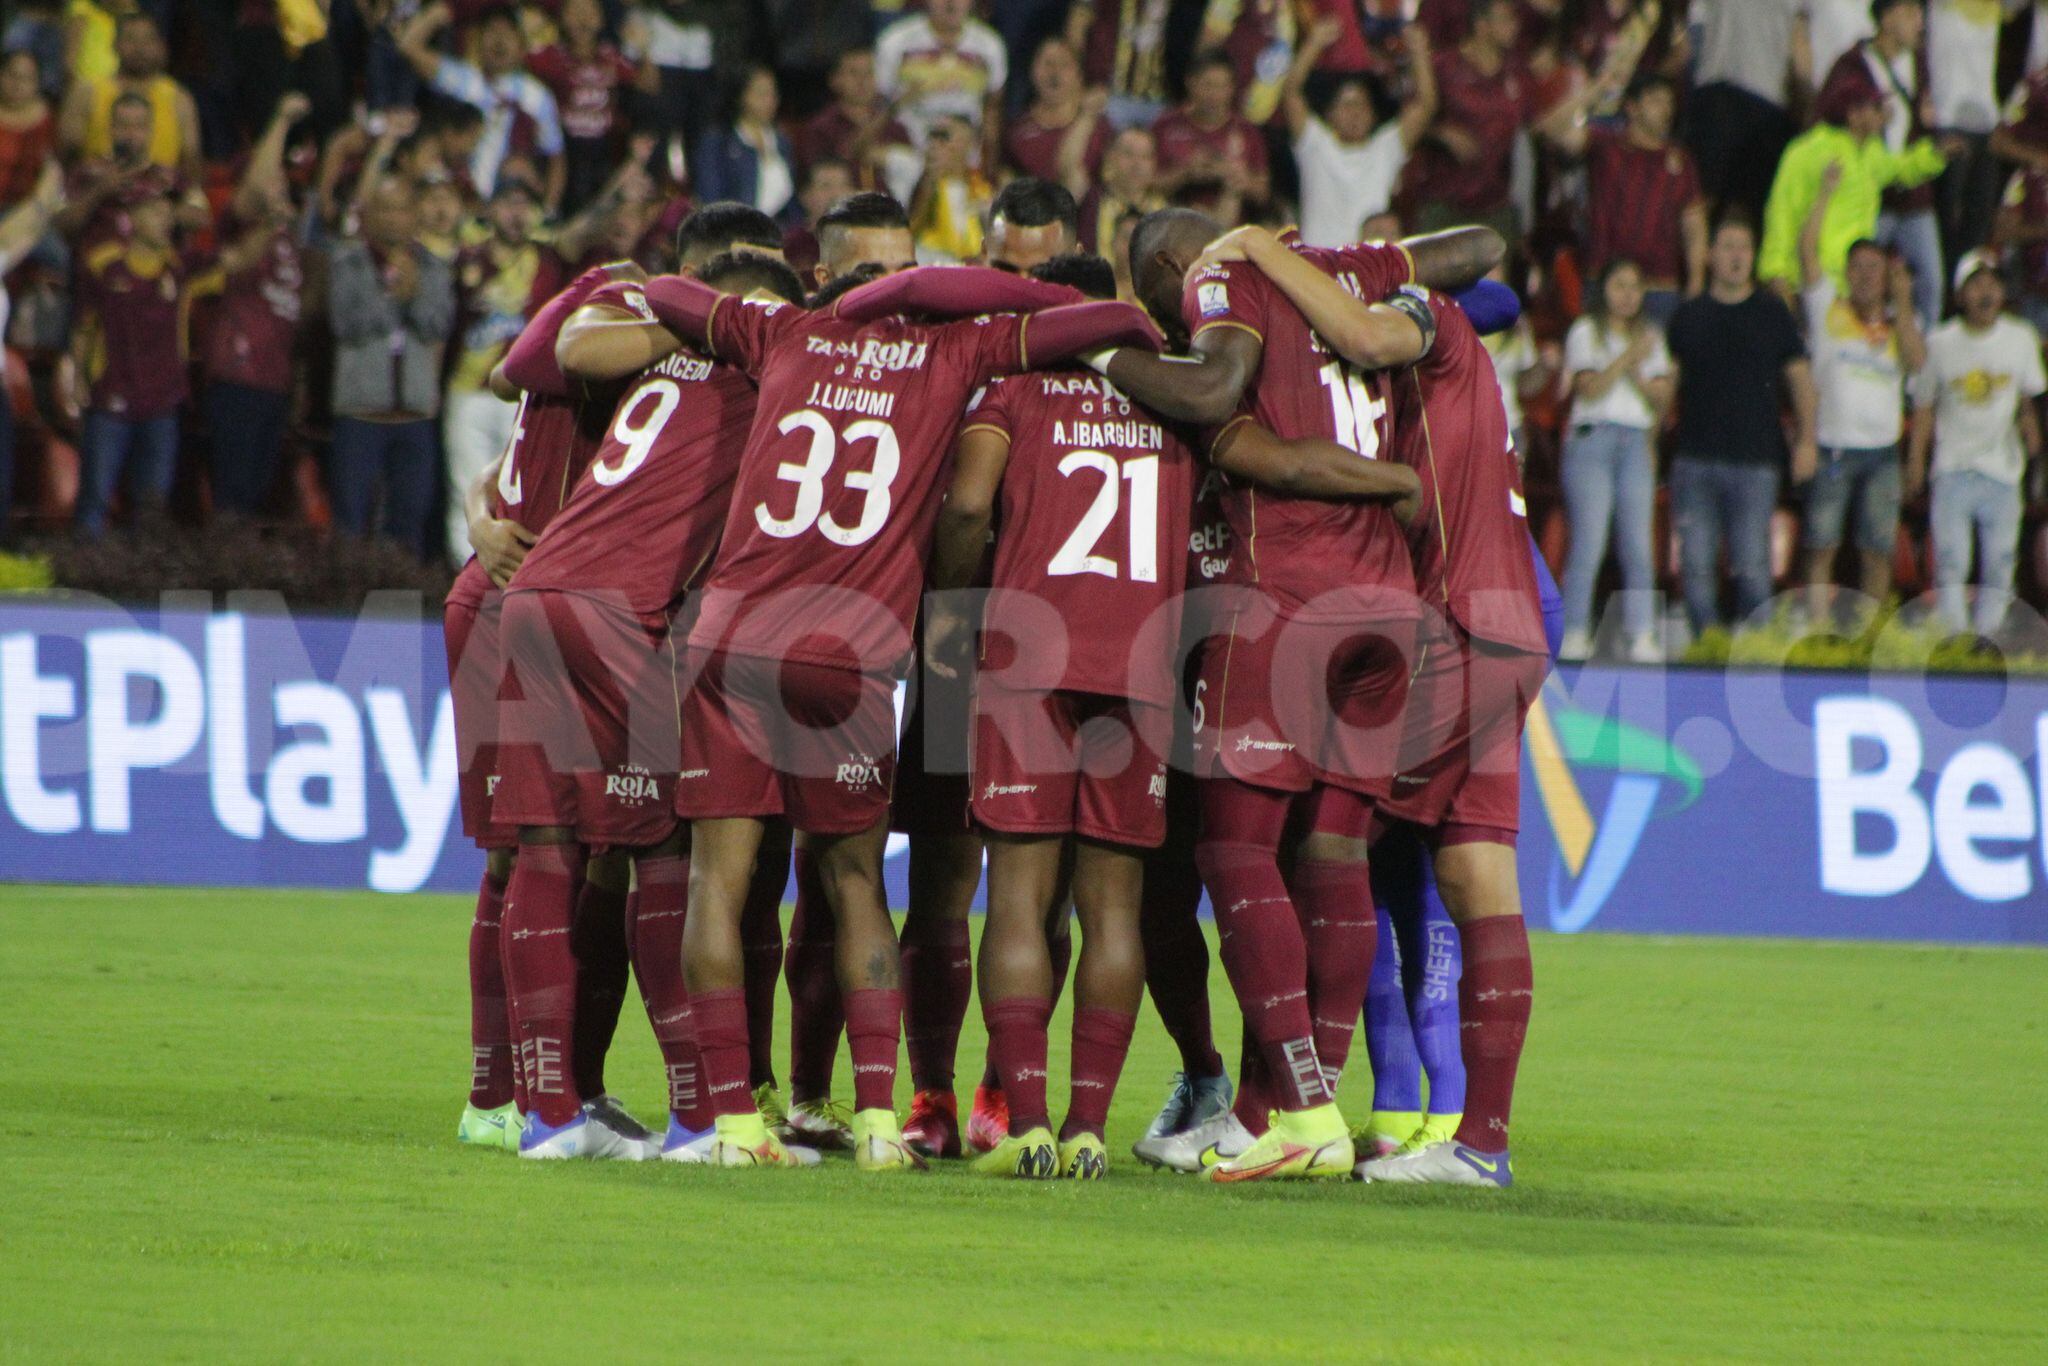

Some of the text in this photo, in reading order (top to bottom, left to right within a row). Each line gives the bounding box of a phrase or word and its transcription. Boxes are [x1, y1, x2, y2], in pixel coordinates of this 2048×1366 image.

[857, 338, 929, 371] ROJA
[834, 362, 882, 381] ORO
[1042, 376, 1101, 395] TAPA
[806, 381, 895, 418] J.LUCUMI
[1081, 401, 1131, 416] ORO
[592, 379, 681, 487] 9
[1053, 419, 1163, 450] A.IBARGÜEN
[754, 409, 901, 547] 33
[1047, 449, 1159, 583] 21
[849, 753, 875, 765] TPA
[1252, 741, 1296, 752] SHEFFY
[618, 764, 650, 775] TAPA
[835, 763, 883, 786] ROJA
[605, 773, 660, 801] ROJA
[998, 784, 1038, 795] SHEFFY
[1814, 695, 2048, 902] Be
